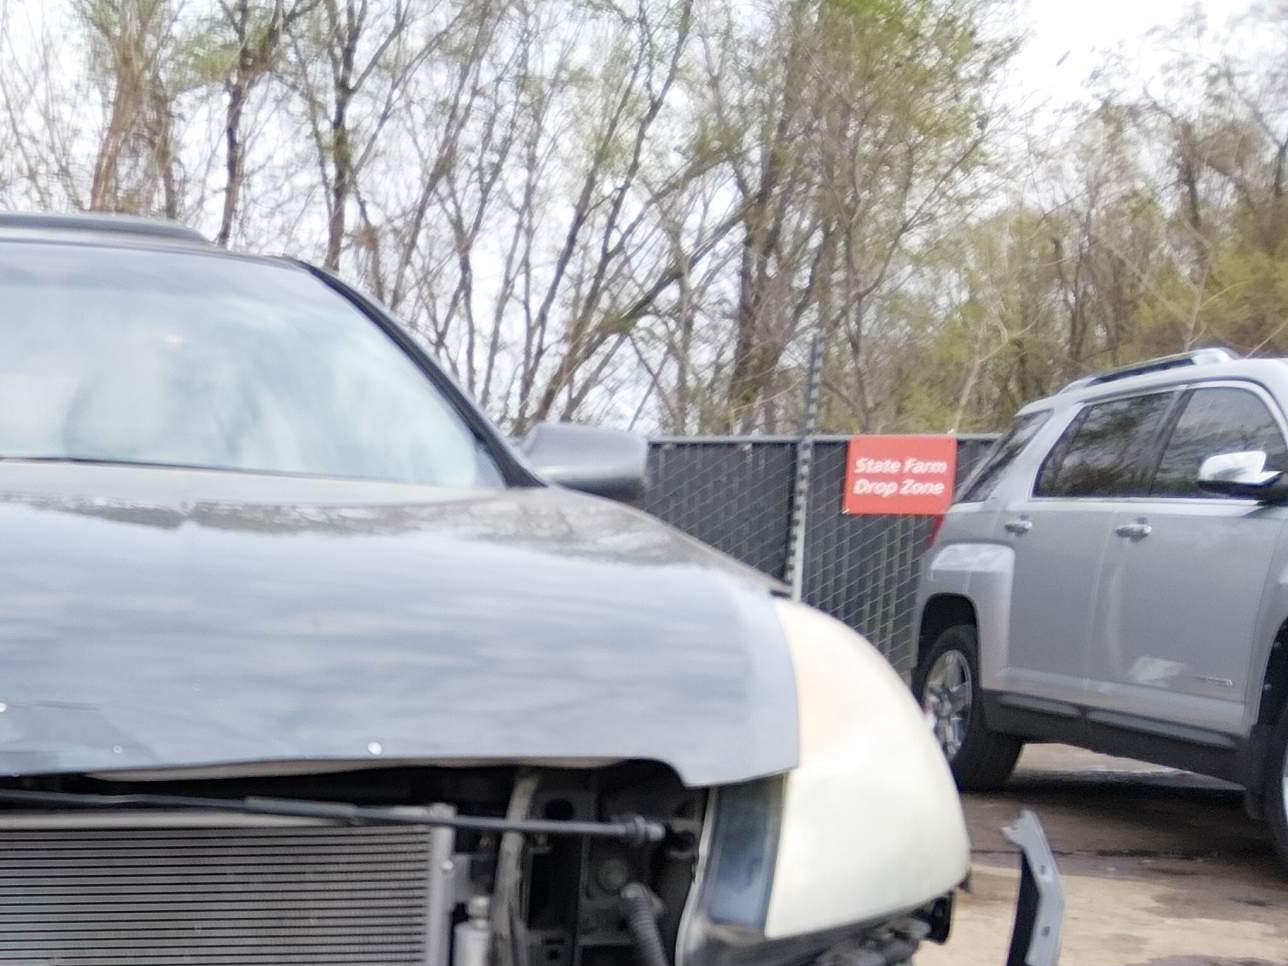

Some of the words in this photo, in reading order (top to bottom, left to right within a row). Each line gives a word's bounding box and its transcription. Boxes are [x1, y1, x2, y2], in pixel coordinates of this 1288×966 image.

[855, 457, 901, 473] State
[904, 458, 947, 473] Farm
[853, 479, 898, 497] Drop
[900, 479, 944, 495] Zone
